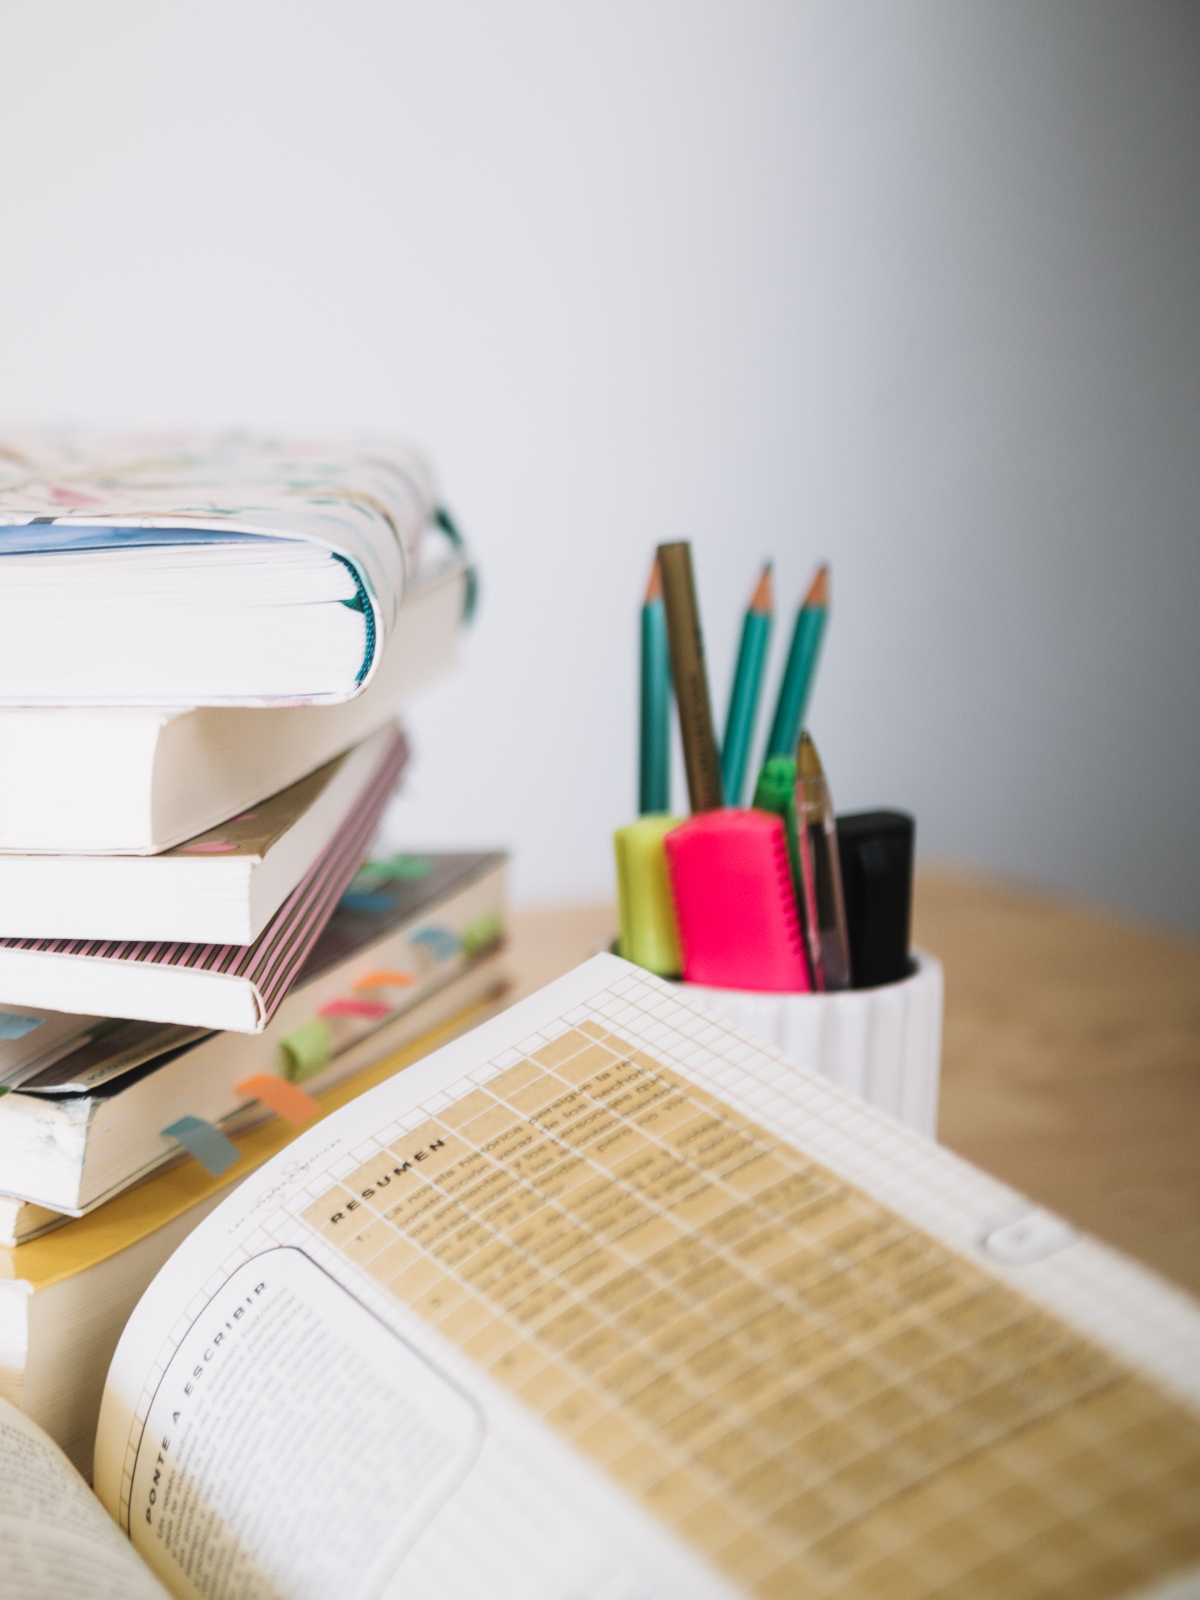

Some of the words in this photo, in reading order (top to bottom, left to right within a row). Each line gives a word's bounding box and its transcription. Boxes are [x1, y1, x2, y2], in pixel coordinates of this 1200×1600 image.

[406, 1168, 456, 1204] novela
[457, 1125, 524, 1168] histórica
[527, 1083, 592, 1125] persigue
[594, 1071, 612, 1082] la
[495, 1134, 533, 1161] veraz
[539, 1119, 560, 1134] de
[561, 1102, 588, 1119] los
[330, 1139, 445, 1224] RESUMEN
[239, 1285, 289, 1339] histórico
[145, 1436, 170, 1525] PONTE
[171, 1410, 181, 1423] A
[183, 1281, 265, 1395] ESCRIBIR
